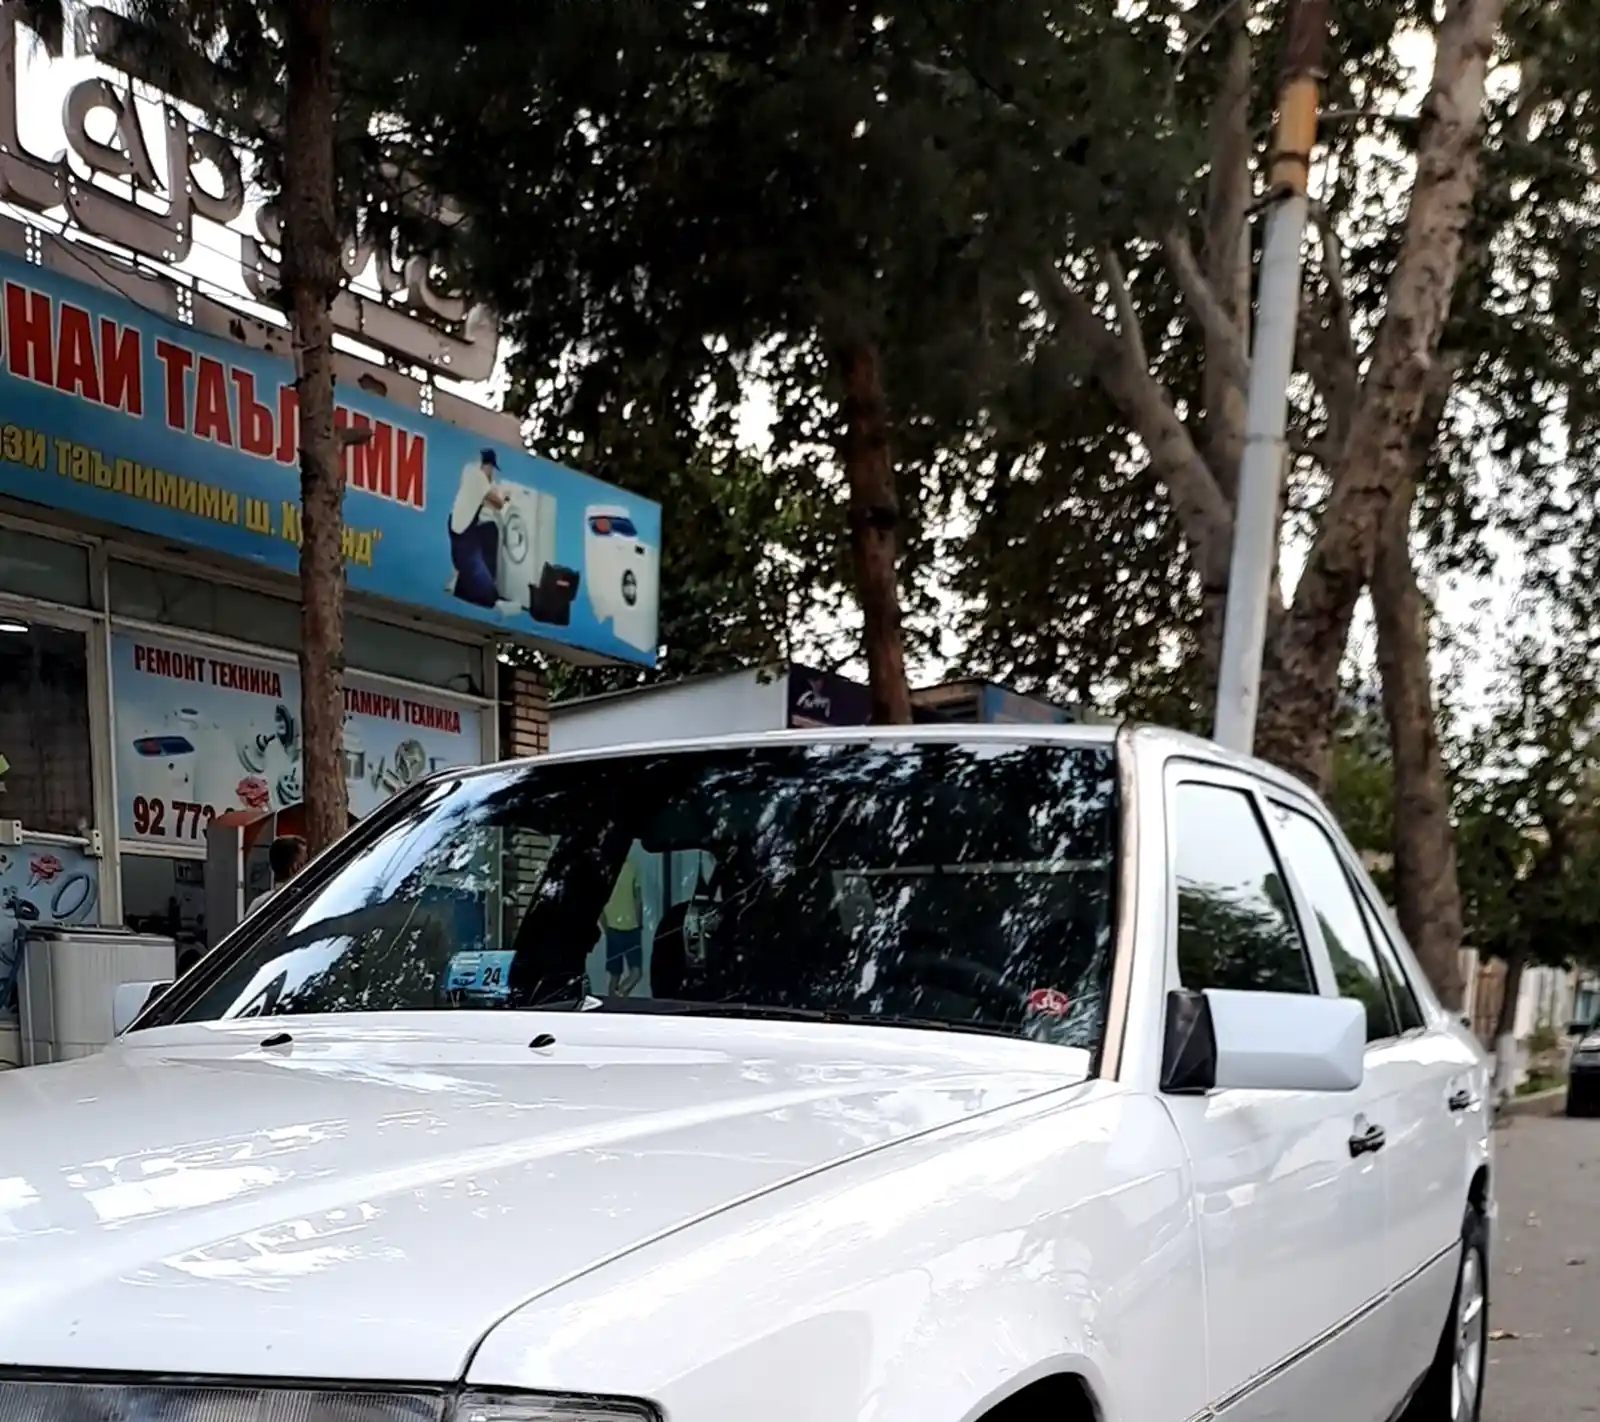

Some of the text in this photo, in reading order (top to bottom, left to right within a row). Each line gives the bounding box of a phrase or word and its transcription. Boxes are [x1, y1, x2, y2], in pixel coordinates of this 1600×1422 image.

[0, 280, 143, 418] НАИ
[0, 424, 47, 471] зи
[134, 645, 282, 698] РЕМОНТ ТЕХНИКА
[342, 687, 462, 734] ТАМИРИ ТЕХНИКА
[133, 795, 165, 835] 92
[482, 966, 502, 986] 24
